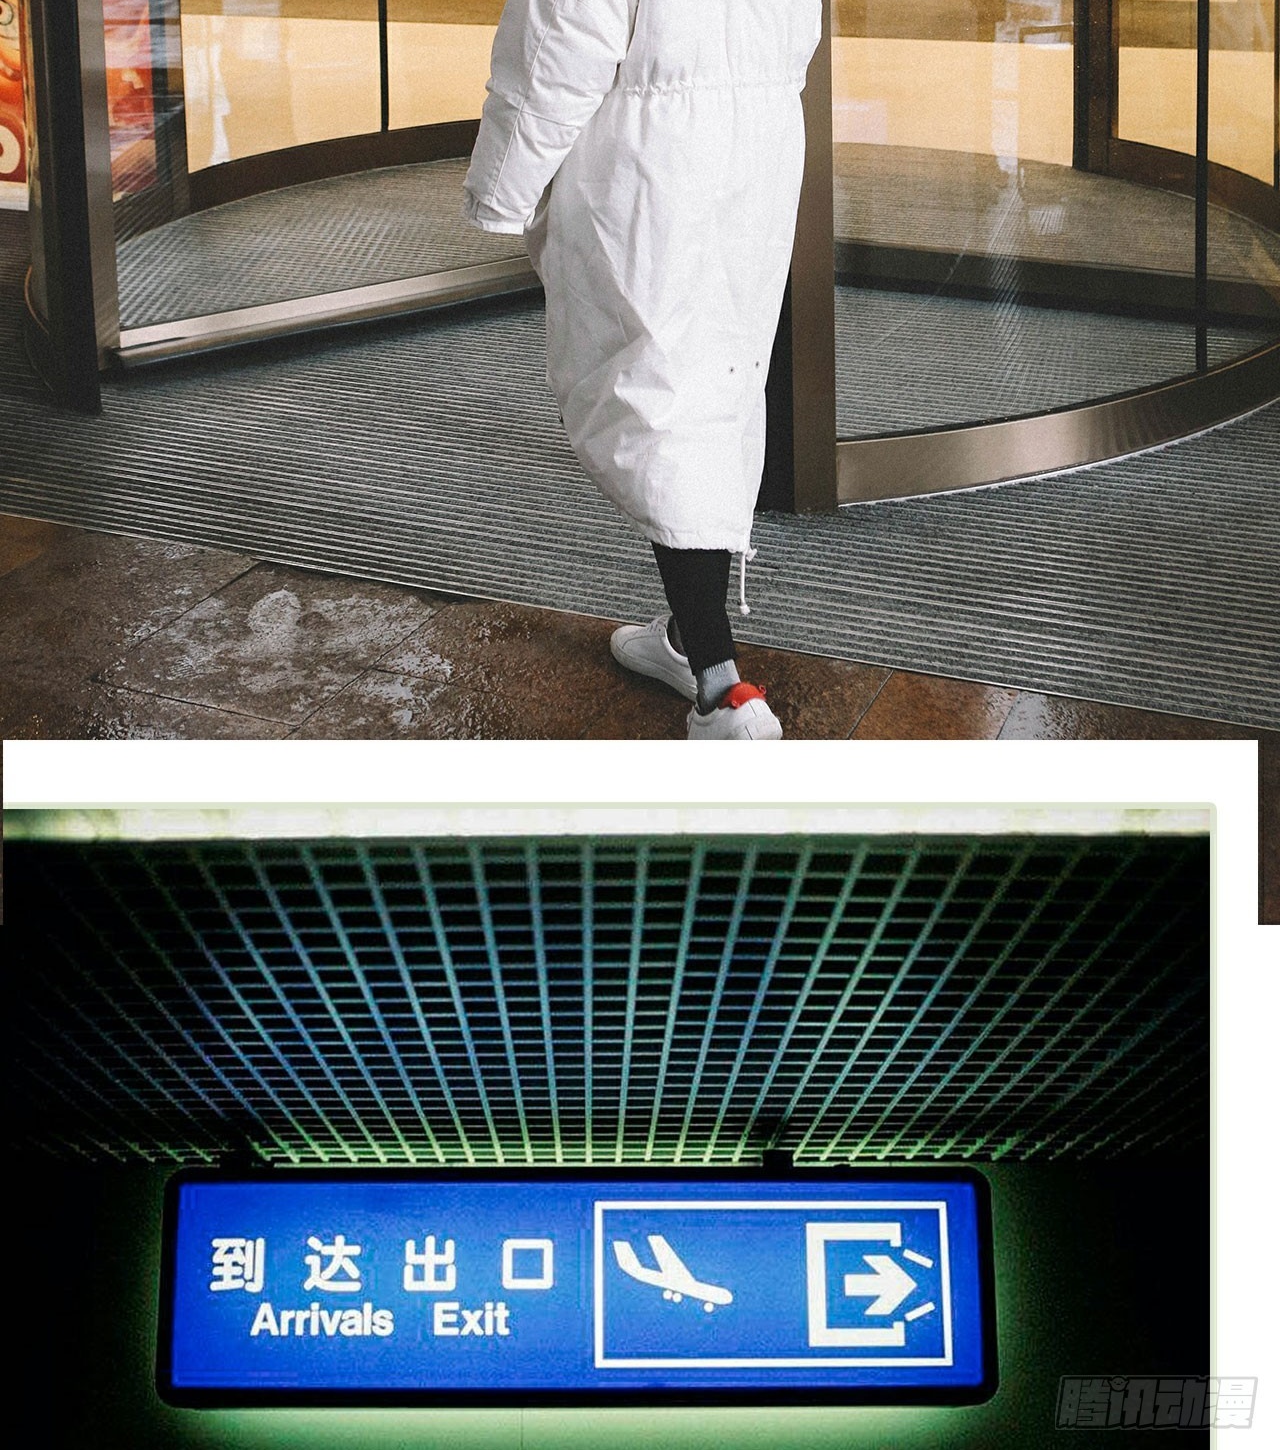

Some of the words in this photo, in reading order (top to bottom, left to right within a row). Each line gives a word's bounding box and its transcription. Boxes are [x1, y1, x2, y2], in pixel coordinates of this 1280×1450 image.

[209, 1234, 554, 1293] 到达出口
[250, 1301, 395, 1337] Arrivals
[433, 1301, 511, 1336] Exit
